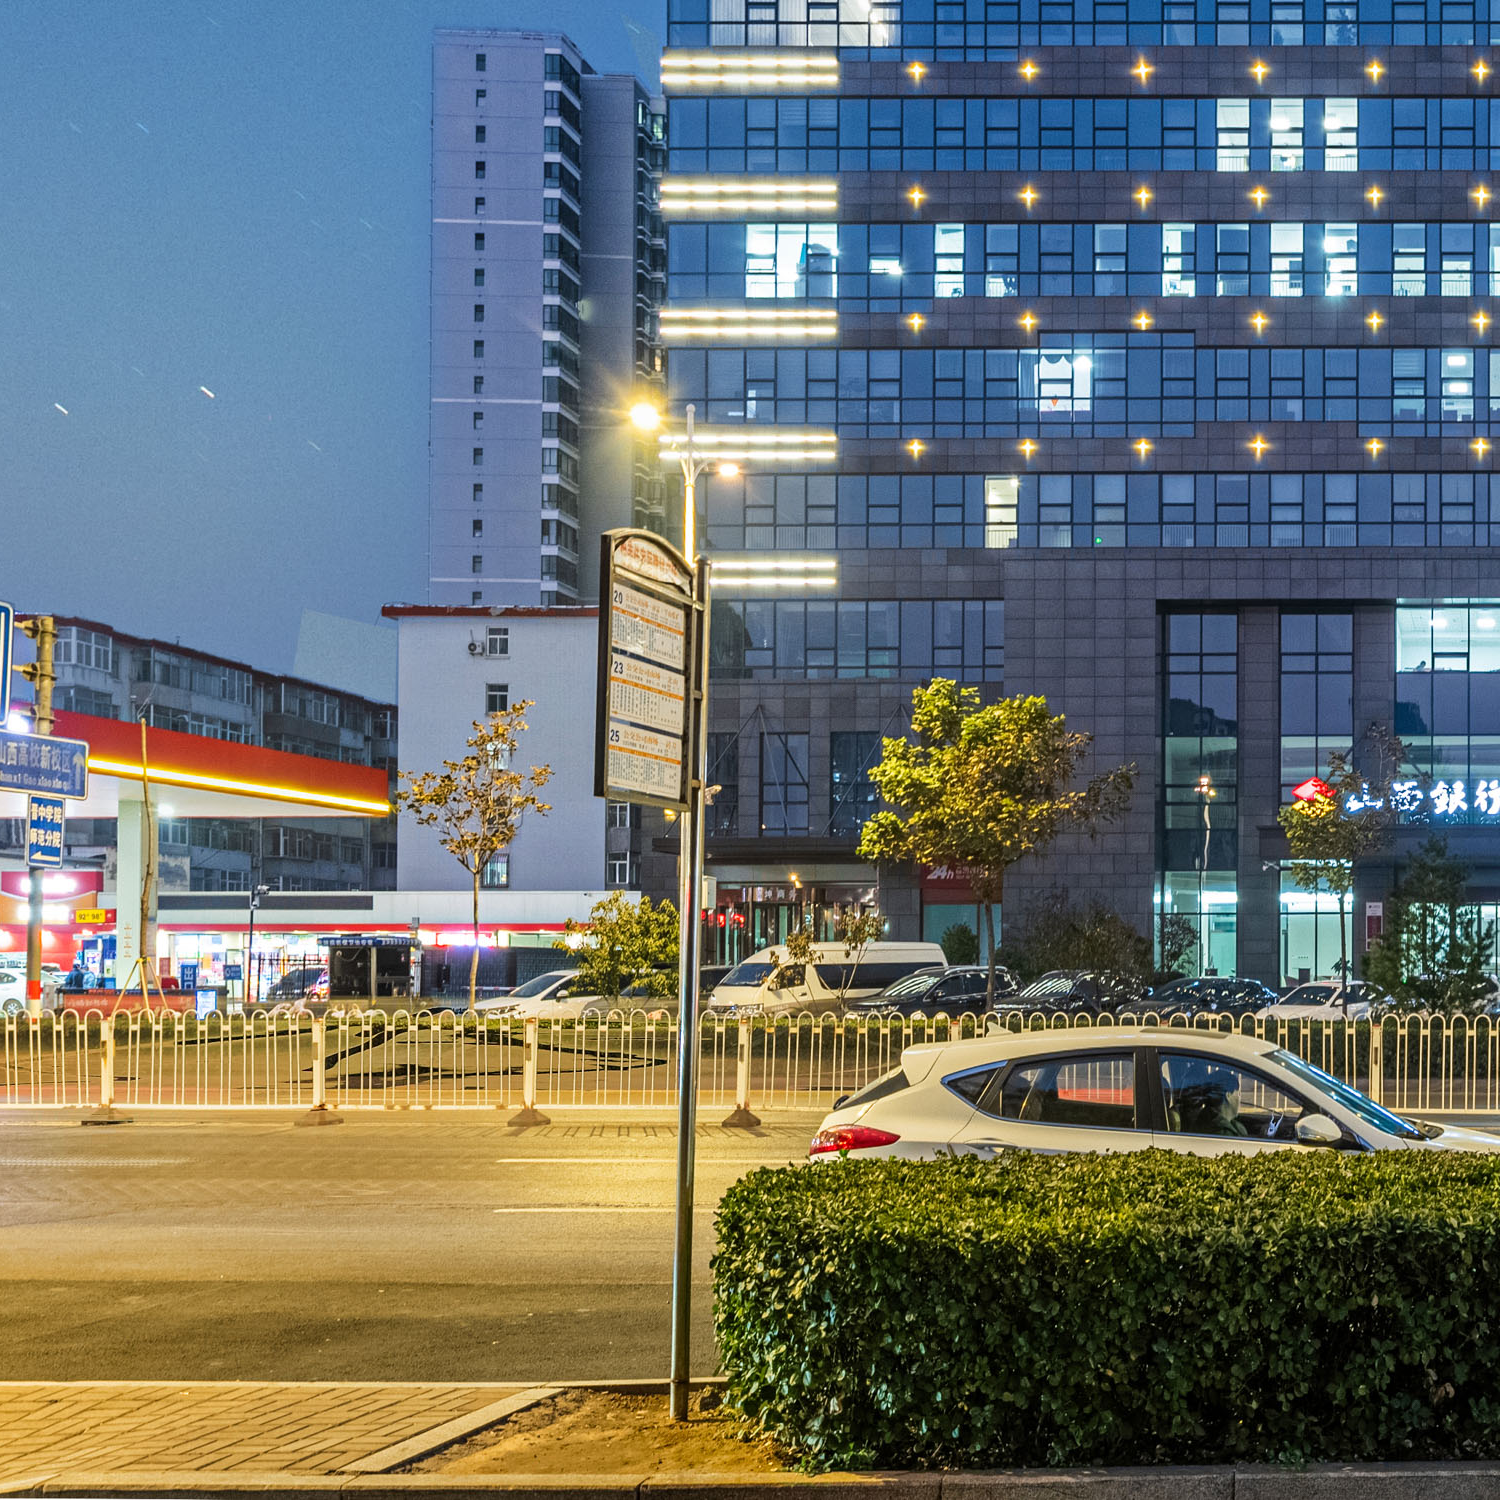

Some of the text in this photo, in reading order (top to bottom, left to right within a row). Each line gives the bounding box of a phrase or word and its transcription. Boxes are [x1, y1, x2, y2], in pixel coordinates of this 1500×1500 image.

[614, 590, 623, 604] 20
[613, 661, 623, 674] 23
[610, 729, 620, 743] 25
